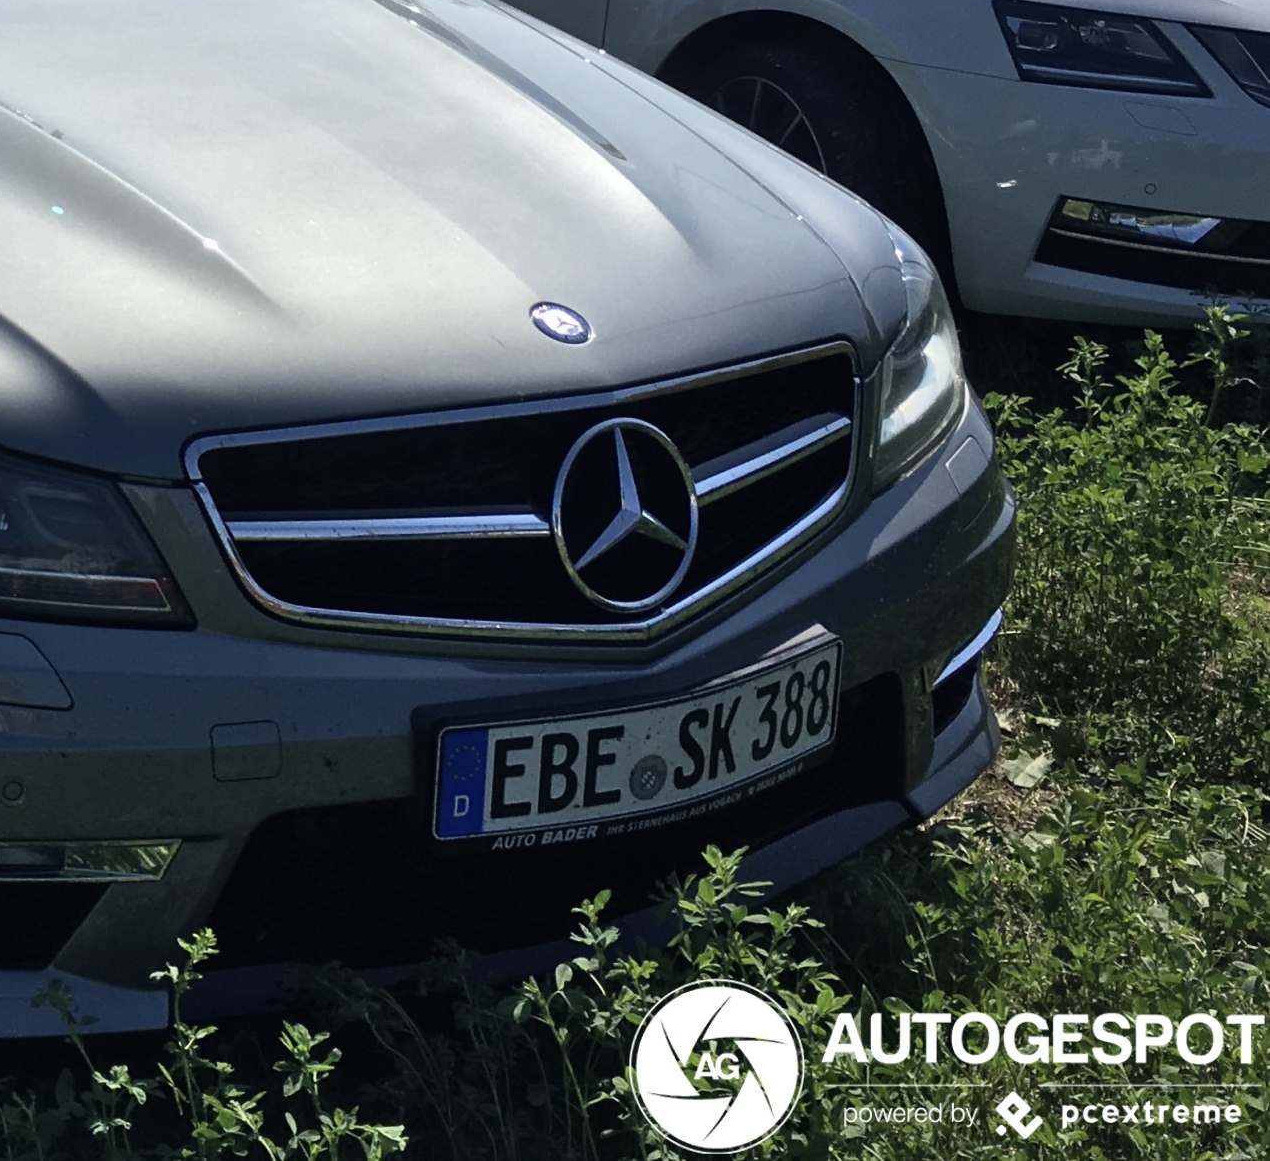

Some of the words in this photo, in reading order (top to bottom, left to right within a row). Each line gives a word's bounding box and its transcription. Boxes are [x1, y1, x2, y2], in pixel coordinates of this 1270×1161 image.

[491, 725, 625, 819] EBE
[673, 695, 741, 790] SK
[751, 660, 830, 761] 388
[453, 795, 470, 817] D
[491, 833, 537, 850] AUTO
[541, 825, 598, 845] BADER
[606, 824, 625, 836] IHR
[627, 810, 687, 832] STERNEHAUS
[688, 804, 708, 818] AUS
